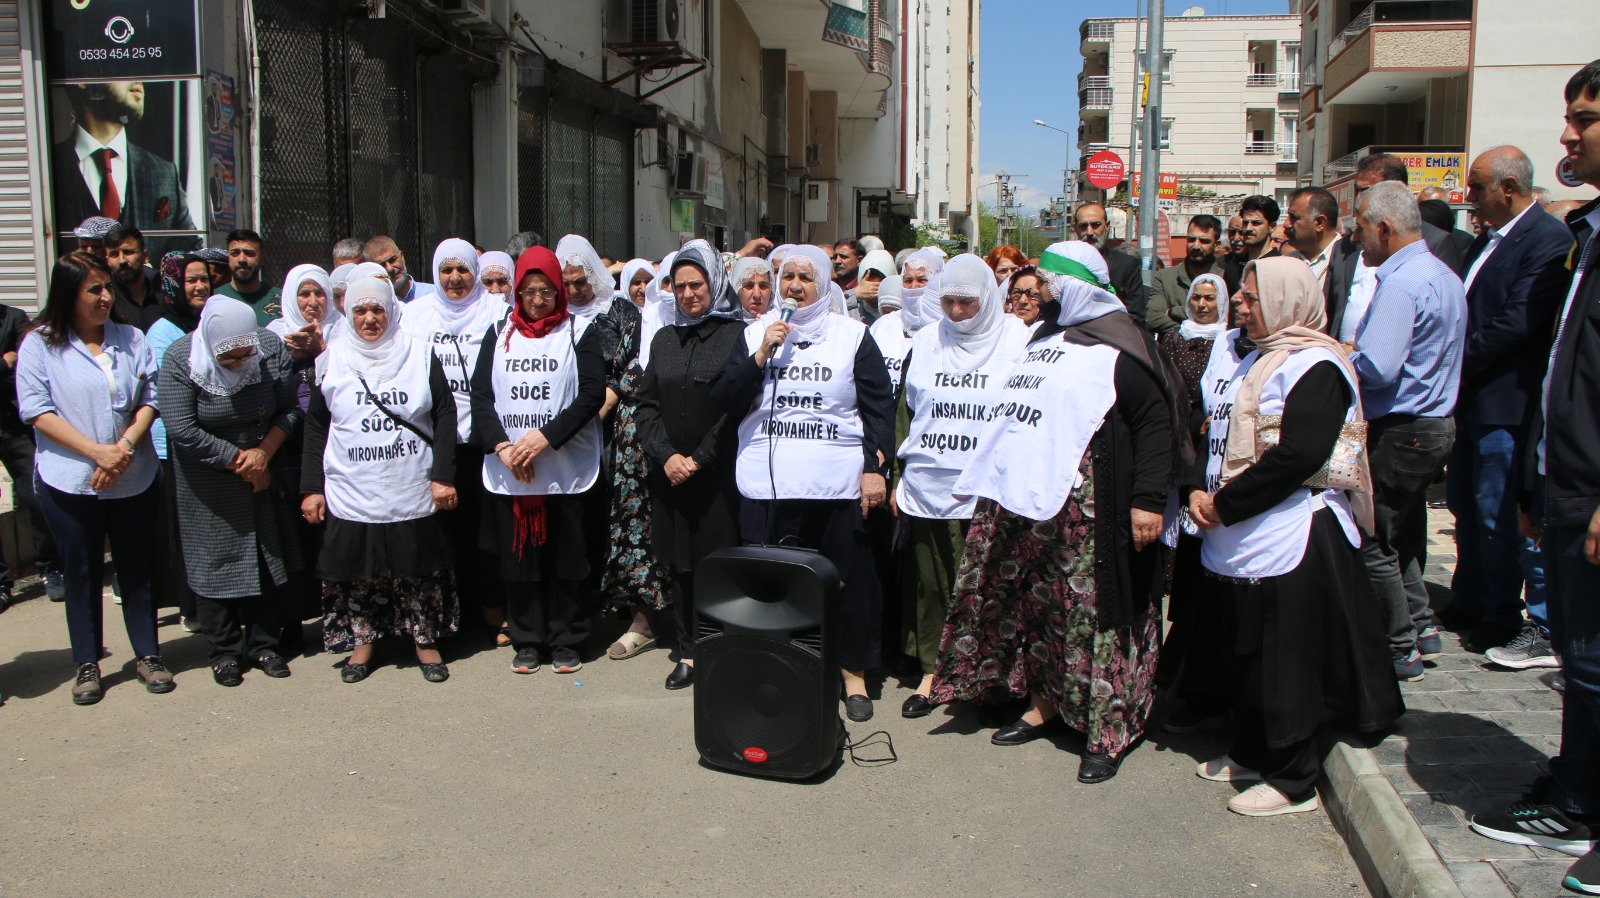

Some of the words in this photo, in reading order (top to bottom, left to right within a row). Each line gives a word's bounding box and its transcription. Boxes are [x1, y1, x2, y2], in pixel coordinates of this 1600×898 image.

[79, 48, 107, 60] 0533
[109, 48, 130, 59] 454
[132, 47, 146, 59] 25
[148, 46, 162, 58] 95
[1425, 157, 1460, 168] EMLAK
[1163, 175, 1175, 184] AV
[505, 354, 559, 372] TECRÎD
[769, 362, 833, 382] TECRÎD
[935, 369, 989, 389] TECRİT
[510, 381, 551, 400] SÛCÊ
[776, 391, 823, 410] SÛCÊ
[931, 398, 986, 421] İNSANLIK
[761, 418, 823, 439] MROVAHIYÊ
[826, 423, 839, 440] YE
[406, 439, 418, 455] YE
[920, 433, 978, 454] SUÇUD
